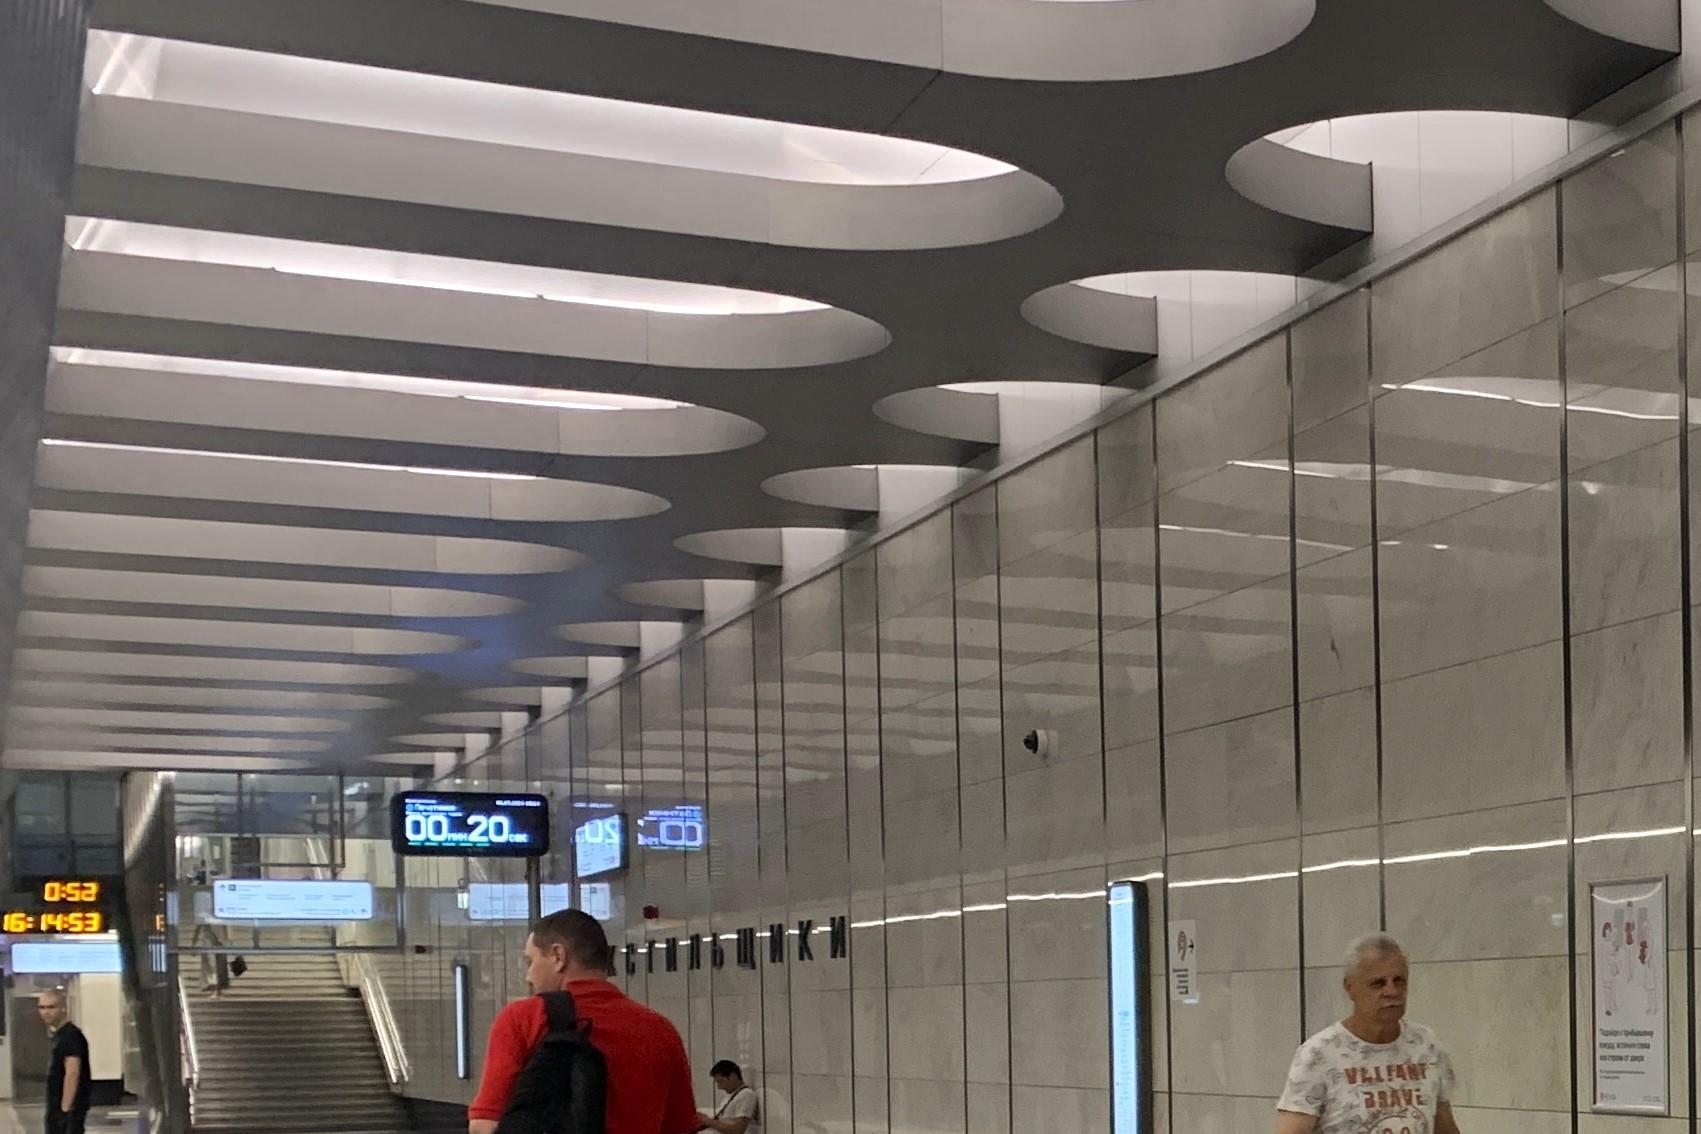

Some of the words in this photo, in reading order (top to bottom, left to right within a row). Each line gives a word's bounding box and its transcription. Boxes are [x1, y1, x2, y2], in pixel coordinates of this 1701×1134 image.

[405, 815, 447, 842] 00
[467, 815, 508, 842] 20
[44, 882, 99, 902] 0:52
